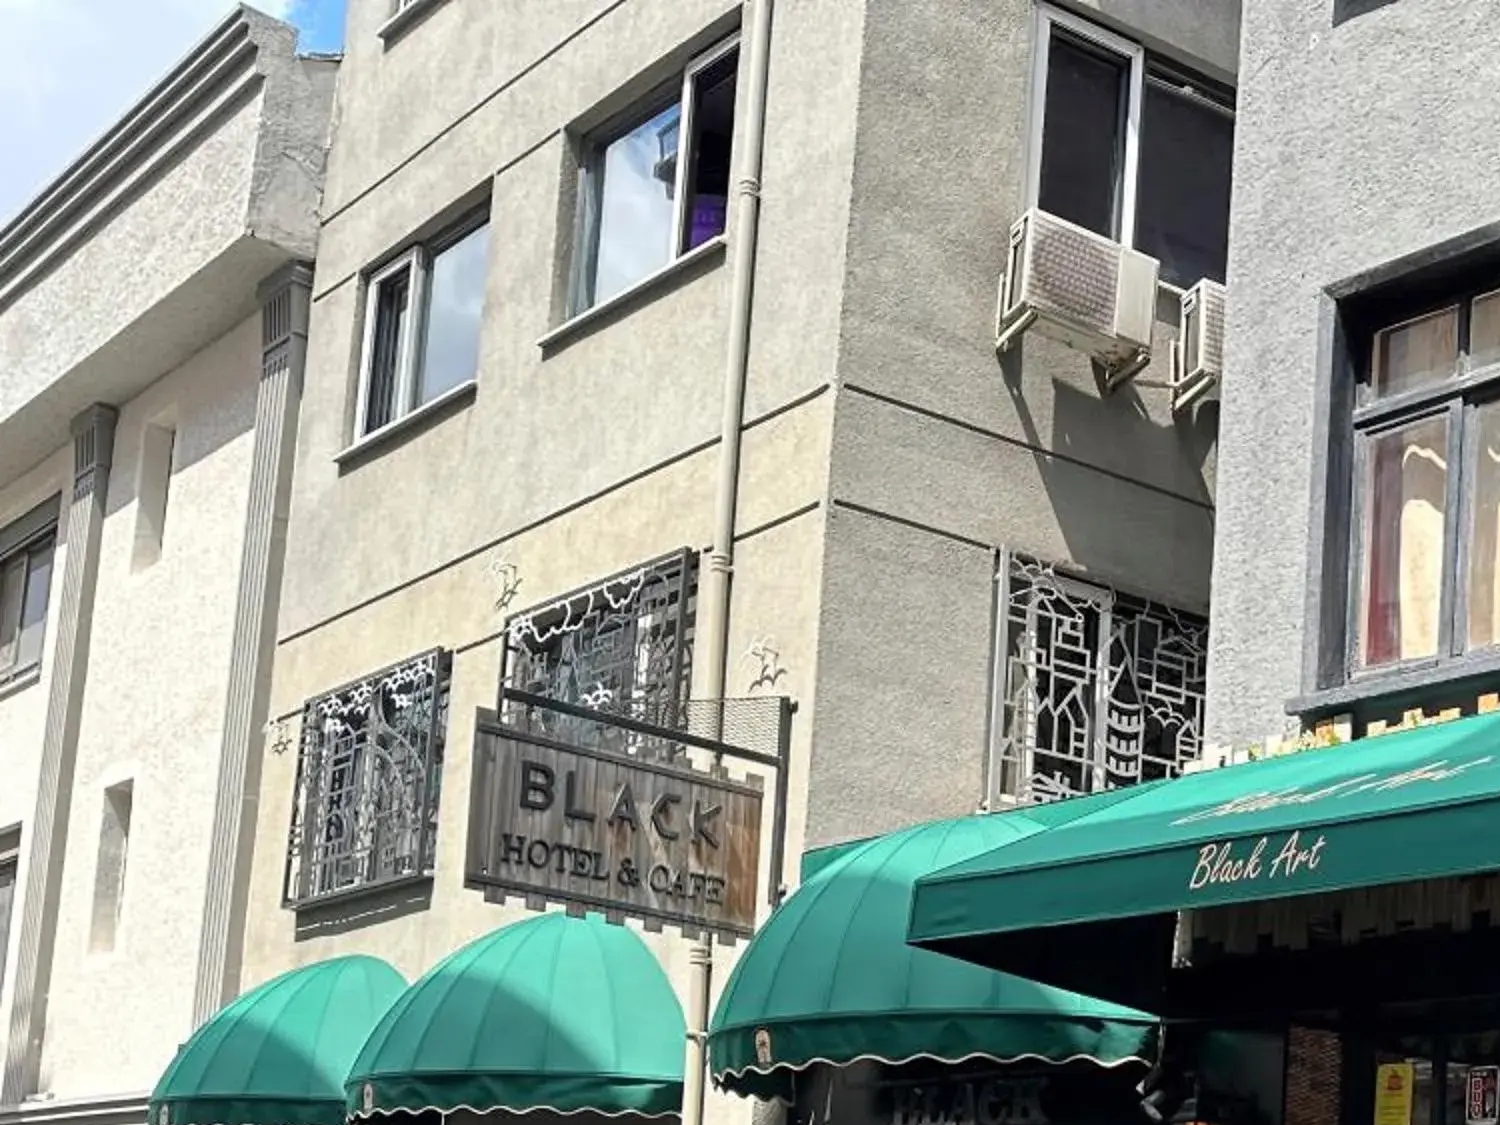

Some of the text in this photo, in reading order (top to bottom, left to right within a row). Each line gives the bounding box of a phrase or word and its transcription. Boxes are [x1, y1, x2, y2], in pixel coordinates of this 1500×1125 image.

[519, 759, 724, 850] BLACK
[500, 833, 726, 906] HOTEL & CAFE
[1189, 830, 1327, 890] Black Art
